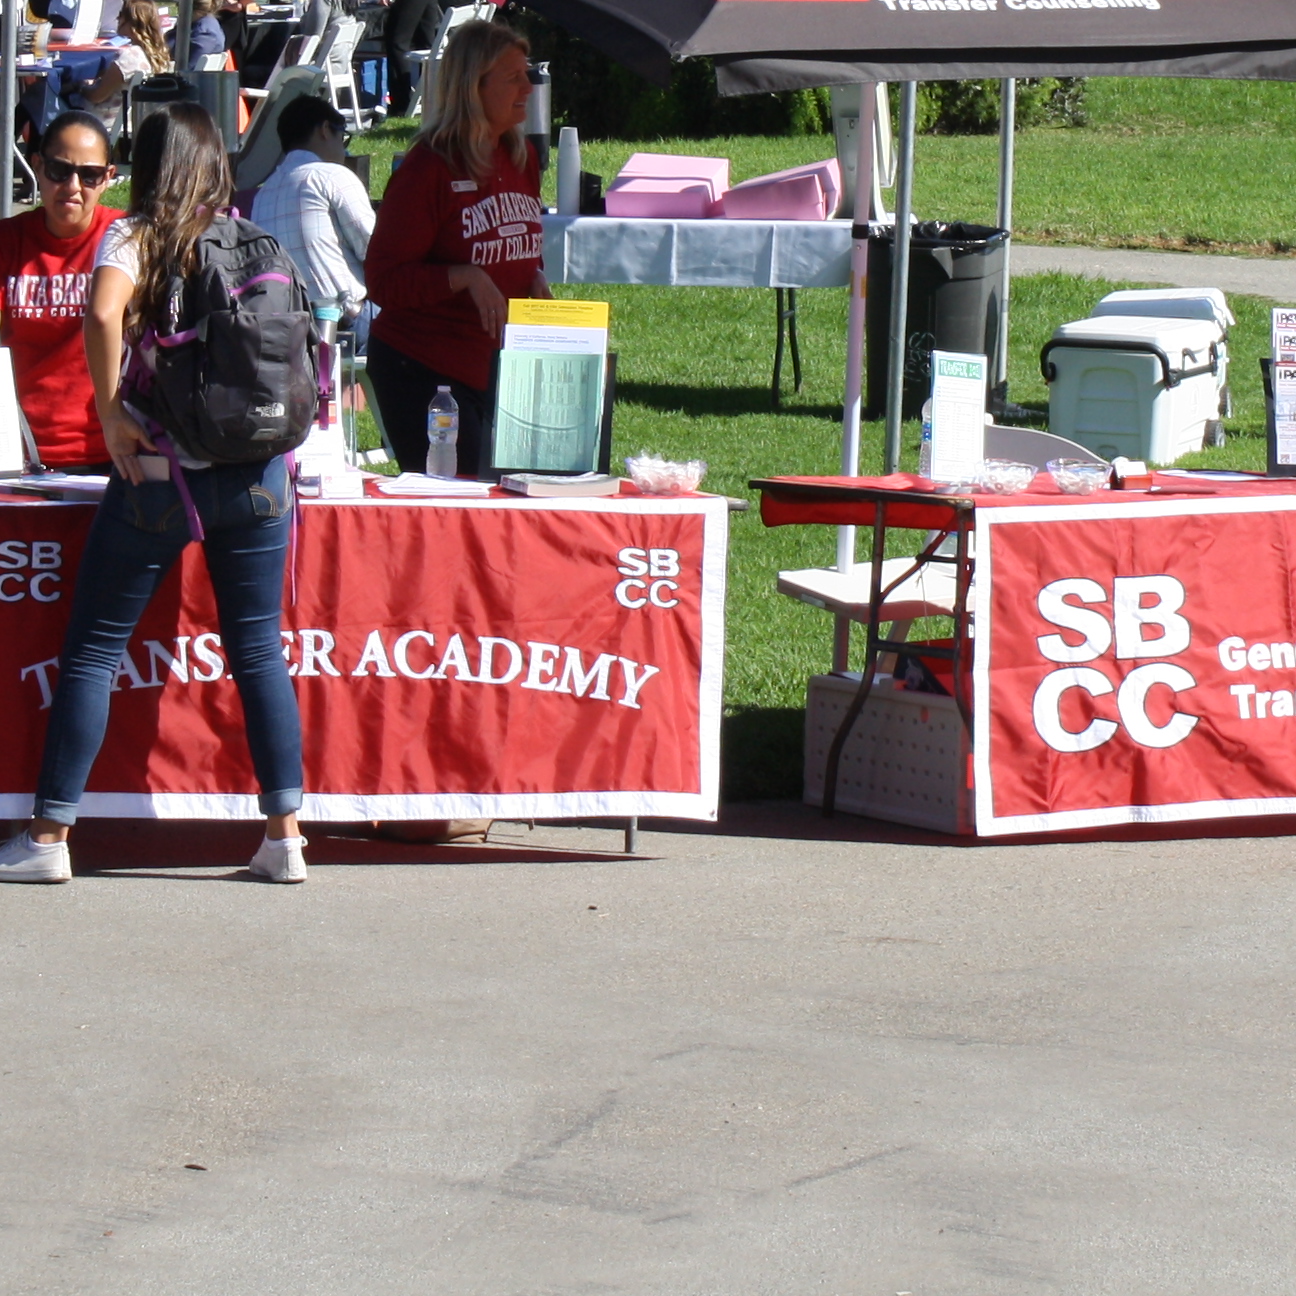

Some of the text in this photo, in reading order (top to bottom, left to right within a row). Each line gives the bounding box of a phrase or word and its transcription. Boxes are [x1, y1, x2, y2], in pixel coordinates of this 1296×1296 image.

[471, 239, 503, 266] CITY
[7, 274, 49, 306] ANTA
[11, 306, 86, 318] CITY COLL
[618, 547, 680, 577] SB
[615, 578, 679, 609] CC
[1036, 573, 1191, 663] SB
[20, 628, 659, 712] TANSER ACADEMY
[1032, 661, 1201, 754] CC
